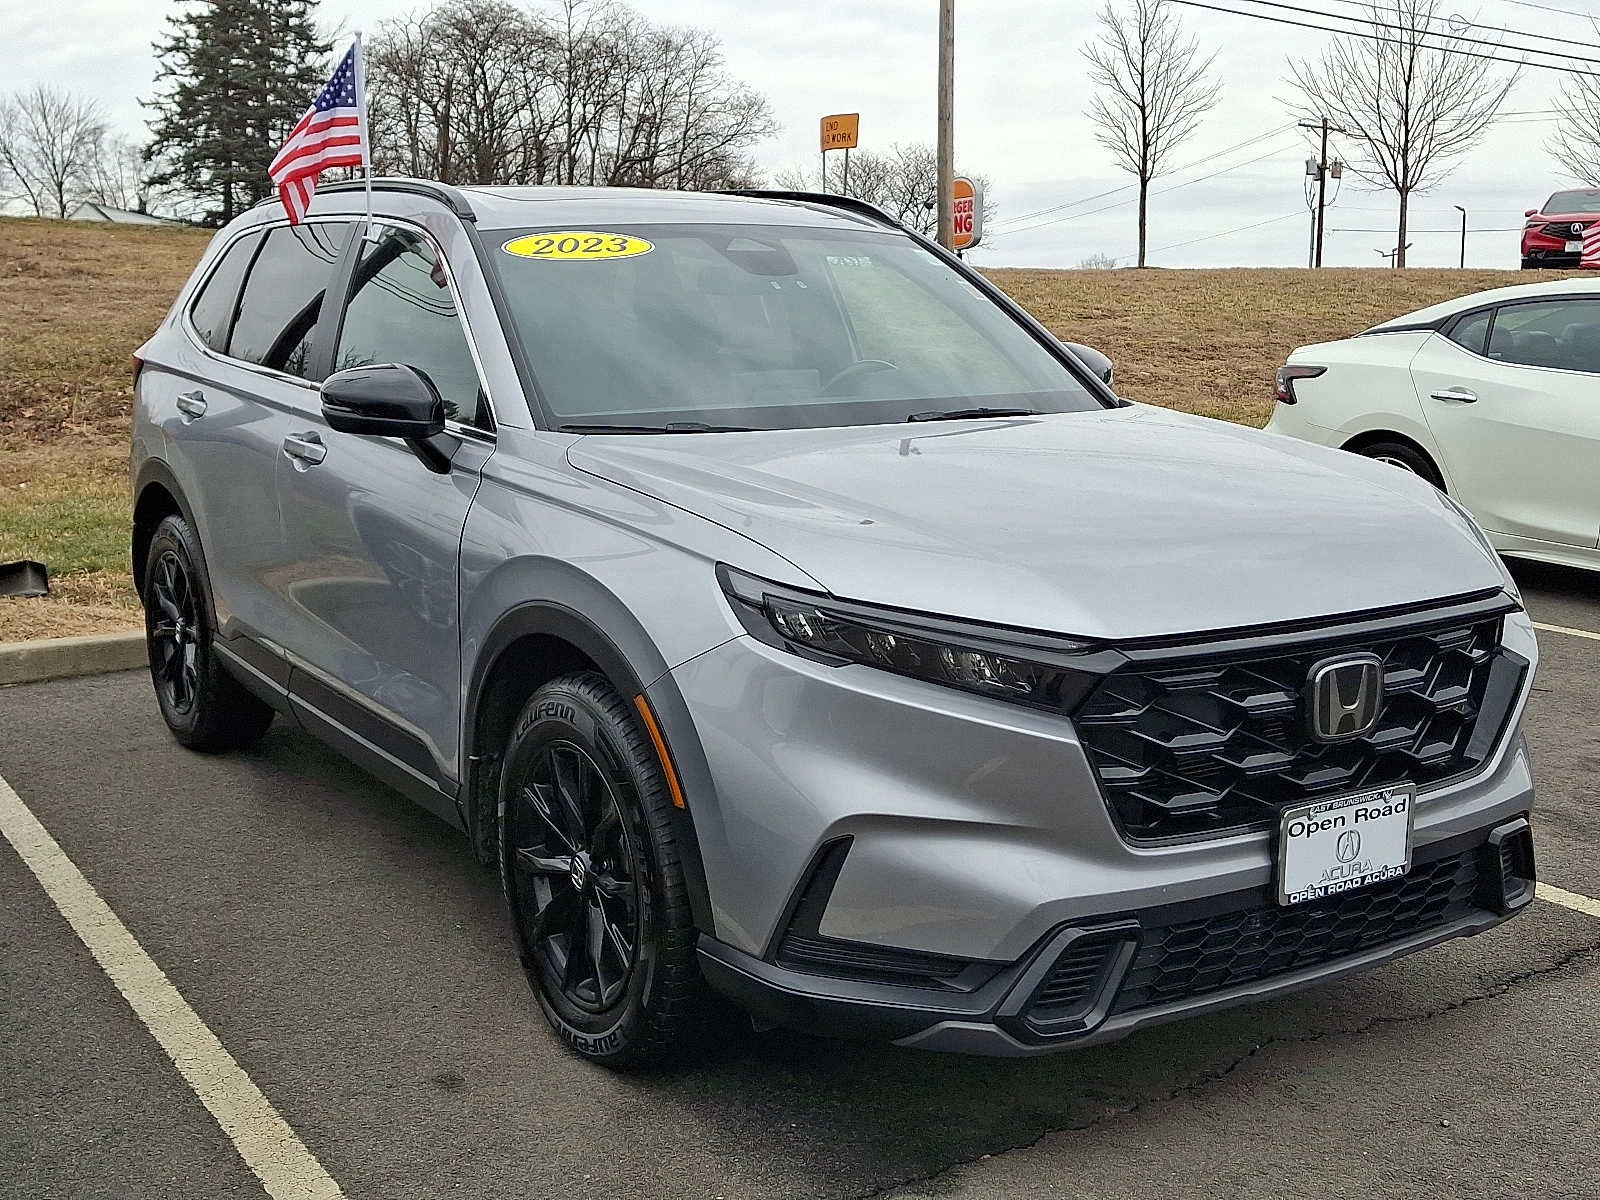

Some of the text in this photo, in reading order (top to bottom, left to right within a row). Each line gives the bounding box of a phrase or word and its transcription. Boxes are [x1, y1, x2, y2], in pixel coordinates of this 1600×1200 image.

[825, 120, 839, 132] END
[831, 132, 852, 143] WORK
[954, 213, 973, 234] NG
[532, 237, 629, 255] 2023
[1288, 798, 1407, 838] Open Road
[1310, 803, 1333, 816] EAST
[1319, 858, 1374, 883] ACURA
[1290, 866, 1404, 904] OPEN ROAD ACURA
